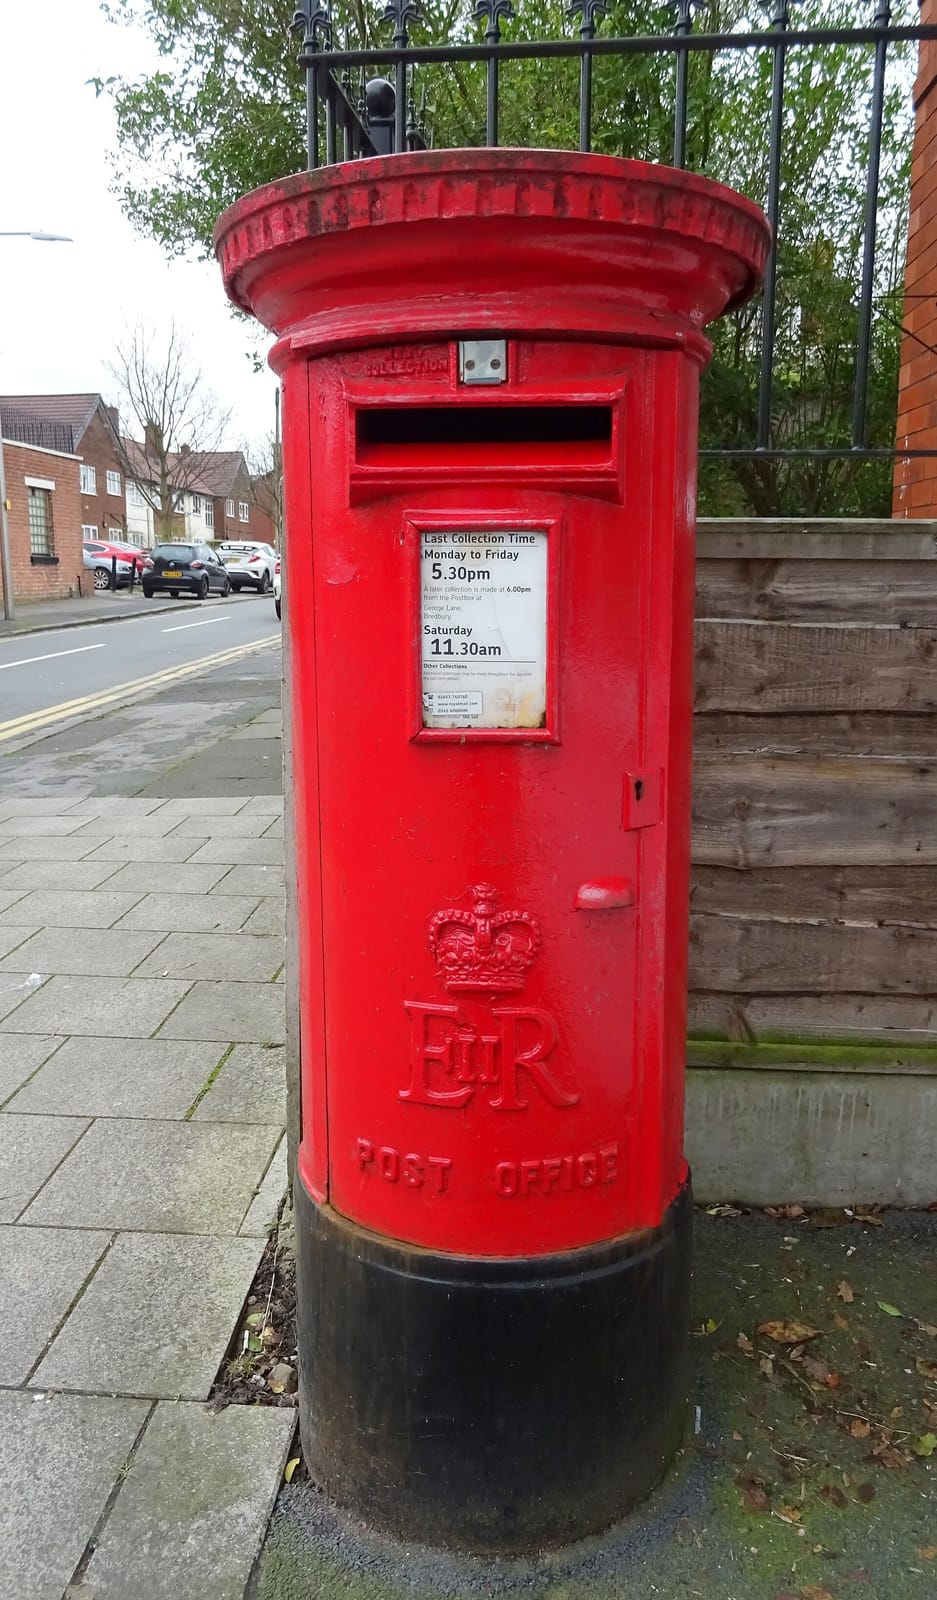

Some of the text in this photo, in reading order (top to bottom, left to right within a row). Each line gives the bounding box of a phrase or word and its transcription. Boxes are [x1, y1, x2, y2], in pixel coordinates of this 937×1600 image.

[424, 533, 536, 544] Last Collection Time
[424, 549, 519, 562] Monday to Friday
[431, 562, 490, 582] 5.30pm
[423, 604, 445, 612] George
[423, 613, 452, 621] Bredbury
[423, 624, 473, 637] Saturday
[430, 638, 502, 656] 11.30am
[355, 1137, 619, 1197] POST OFFICE
